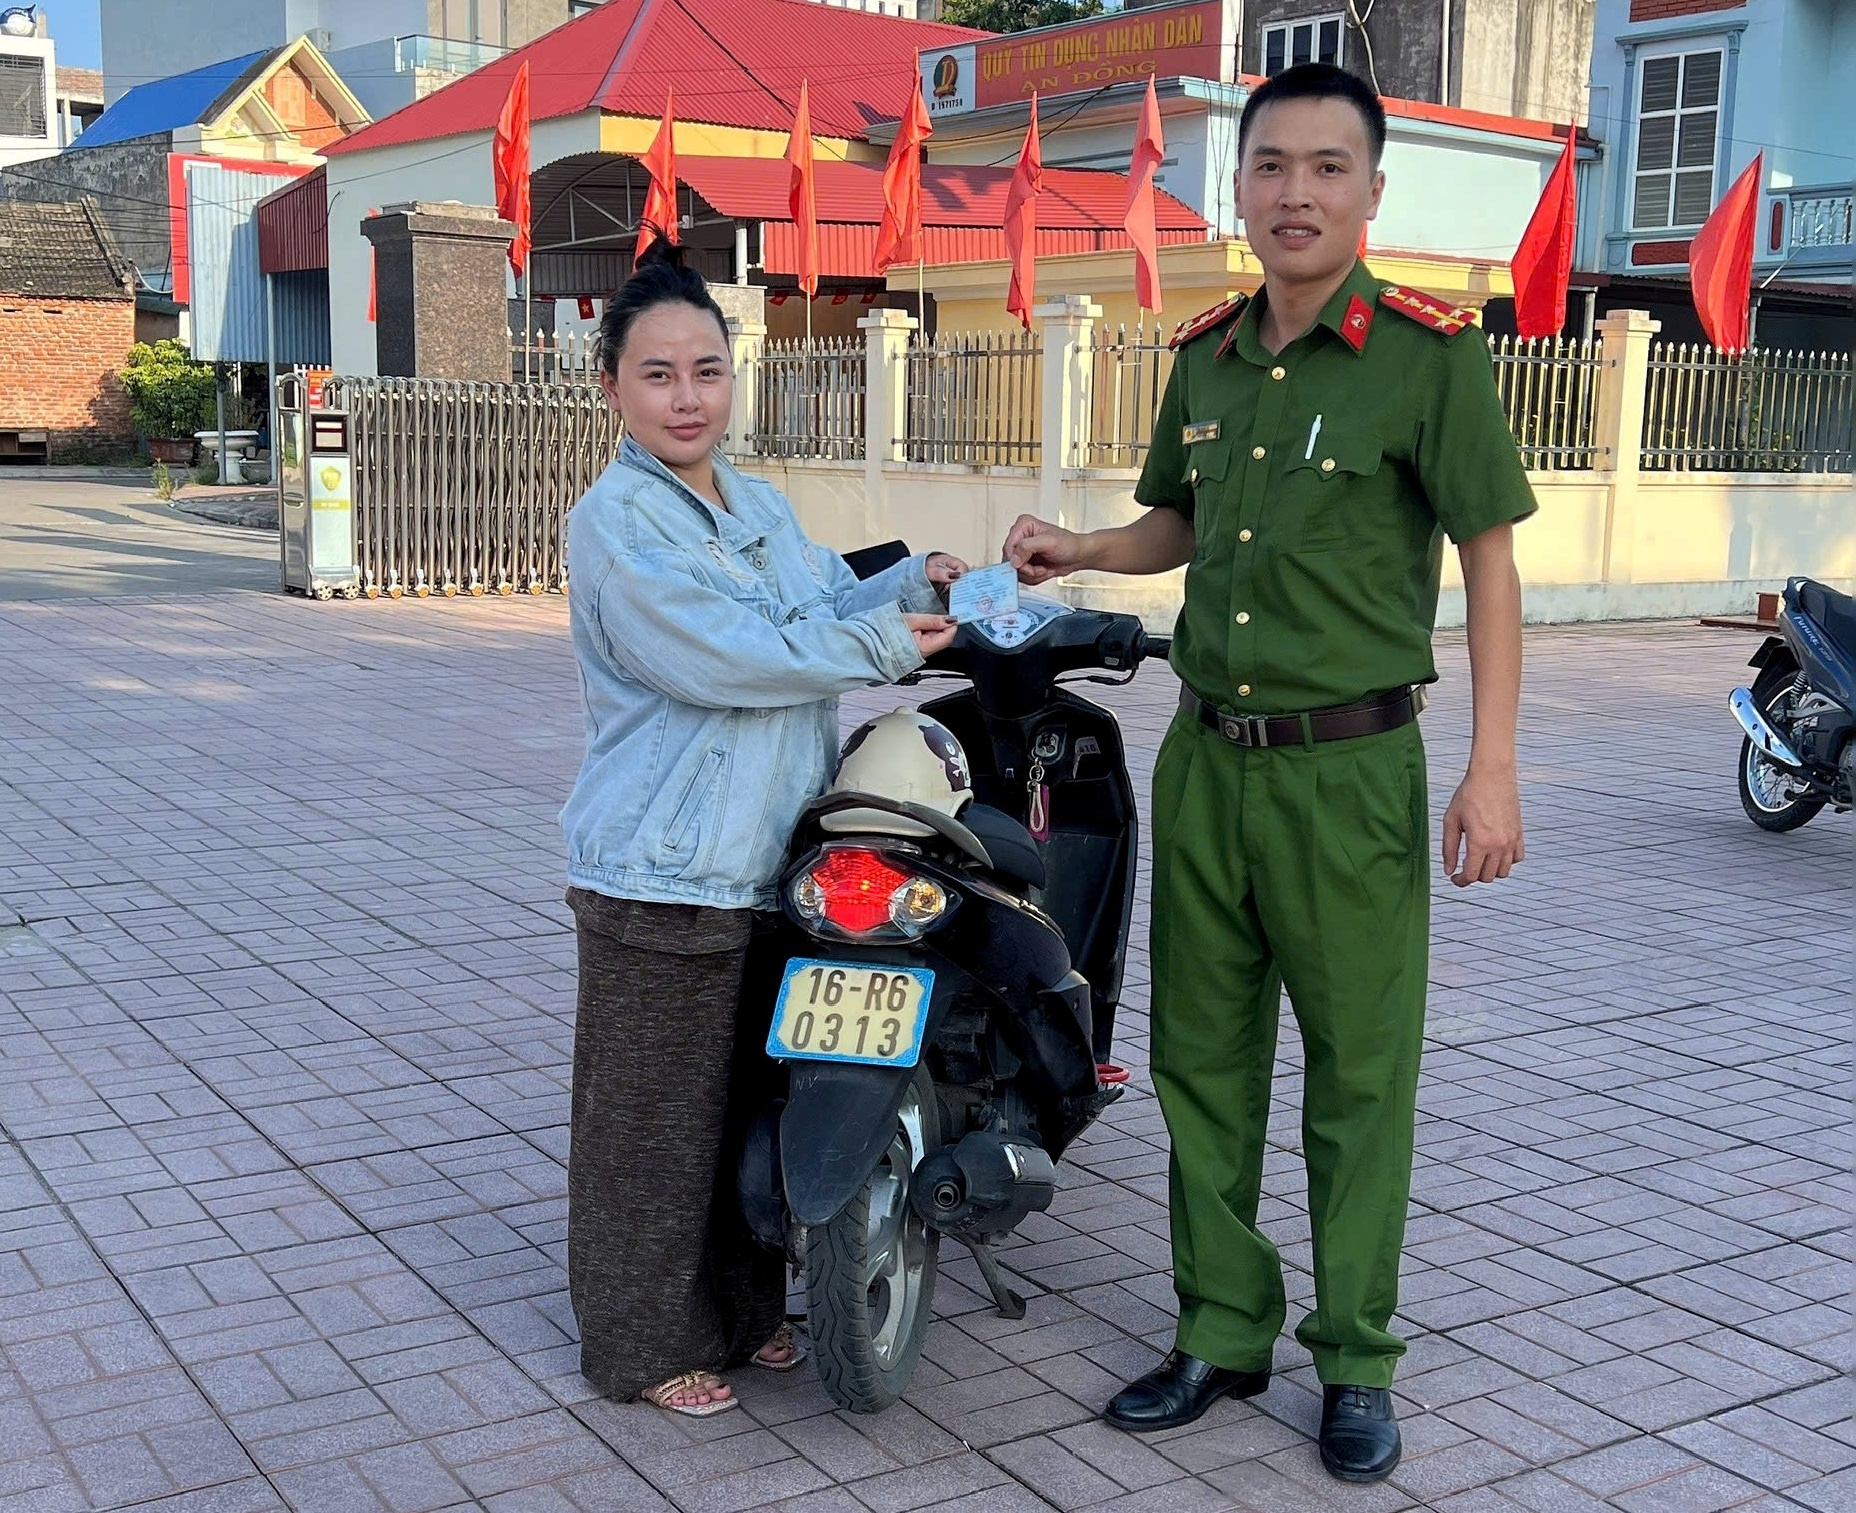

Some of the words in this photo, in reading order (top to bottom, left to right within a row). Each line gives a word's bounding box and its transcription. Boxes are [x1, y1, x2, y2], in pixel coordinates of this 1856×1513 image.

[1053, 32, 1099, 70] DỤNG
[1106, 18, 1156, 57] NHÂN
[1164, 10, 1203, 48] DÂN
[1021, 76, 1059, 93] AN
[809, 968, 909, 1012] 16-R6
[792, 1011, 901, 1057] 0313
